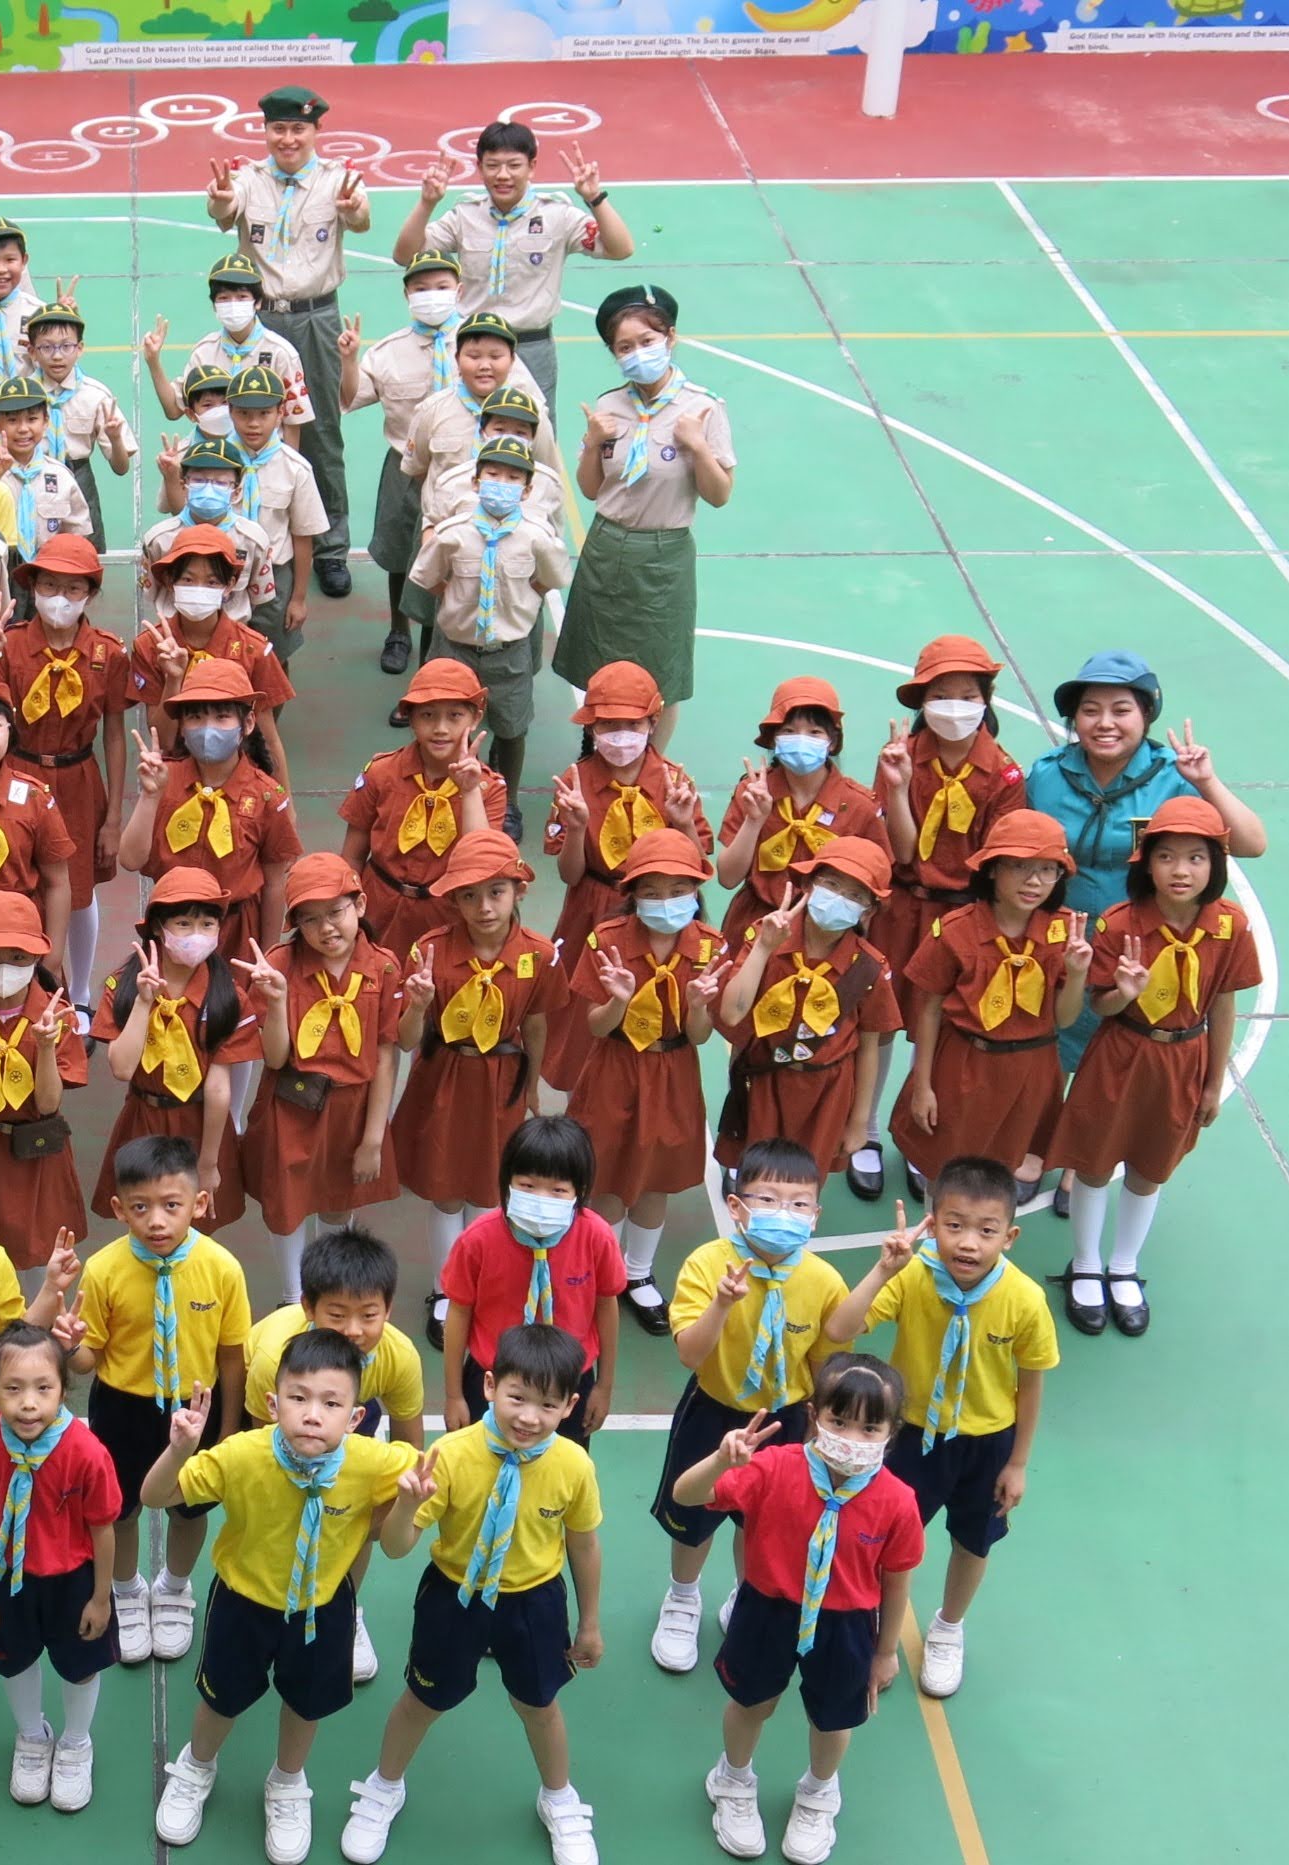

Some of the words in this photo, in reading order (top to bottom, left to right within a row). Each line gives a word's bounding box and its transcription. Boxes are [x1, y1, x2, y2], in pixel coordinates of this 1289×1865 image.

[1070, 32, 1086, 40] God
[1088, 32, 1109, 40] filled
[1168, 32, 1190, 40] living
[103, 46, 140, 55] gathered
[287, 43, 299, 52] dry
[301, 43, 331, 52] ground
[188, 55, 201, 63] the
[203, 55, 221, 63] land
[249, 55, 287, 63] produced
[532, 111, 575, 123] A
[99, 126, 140, 138] G
